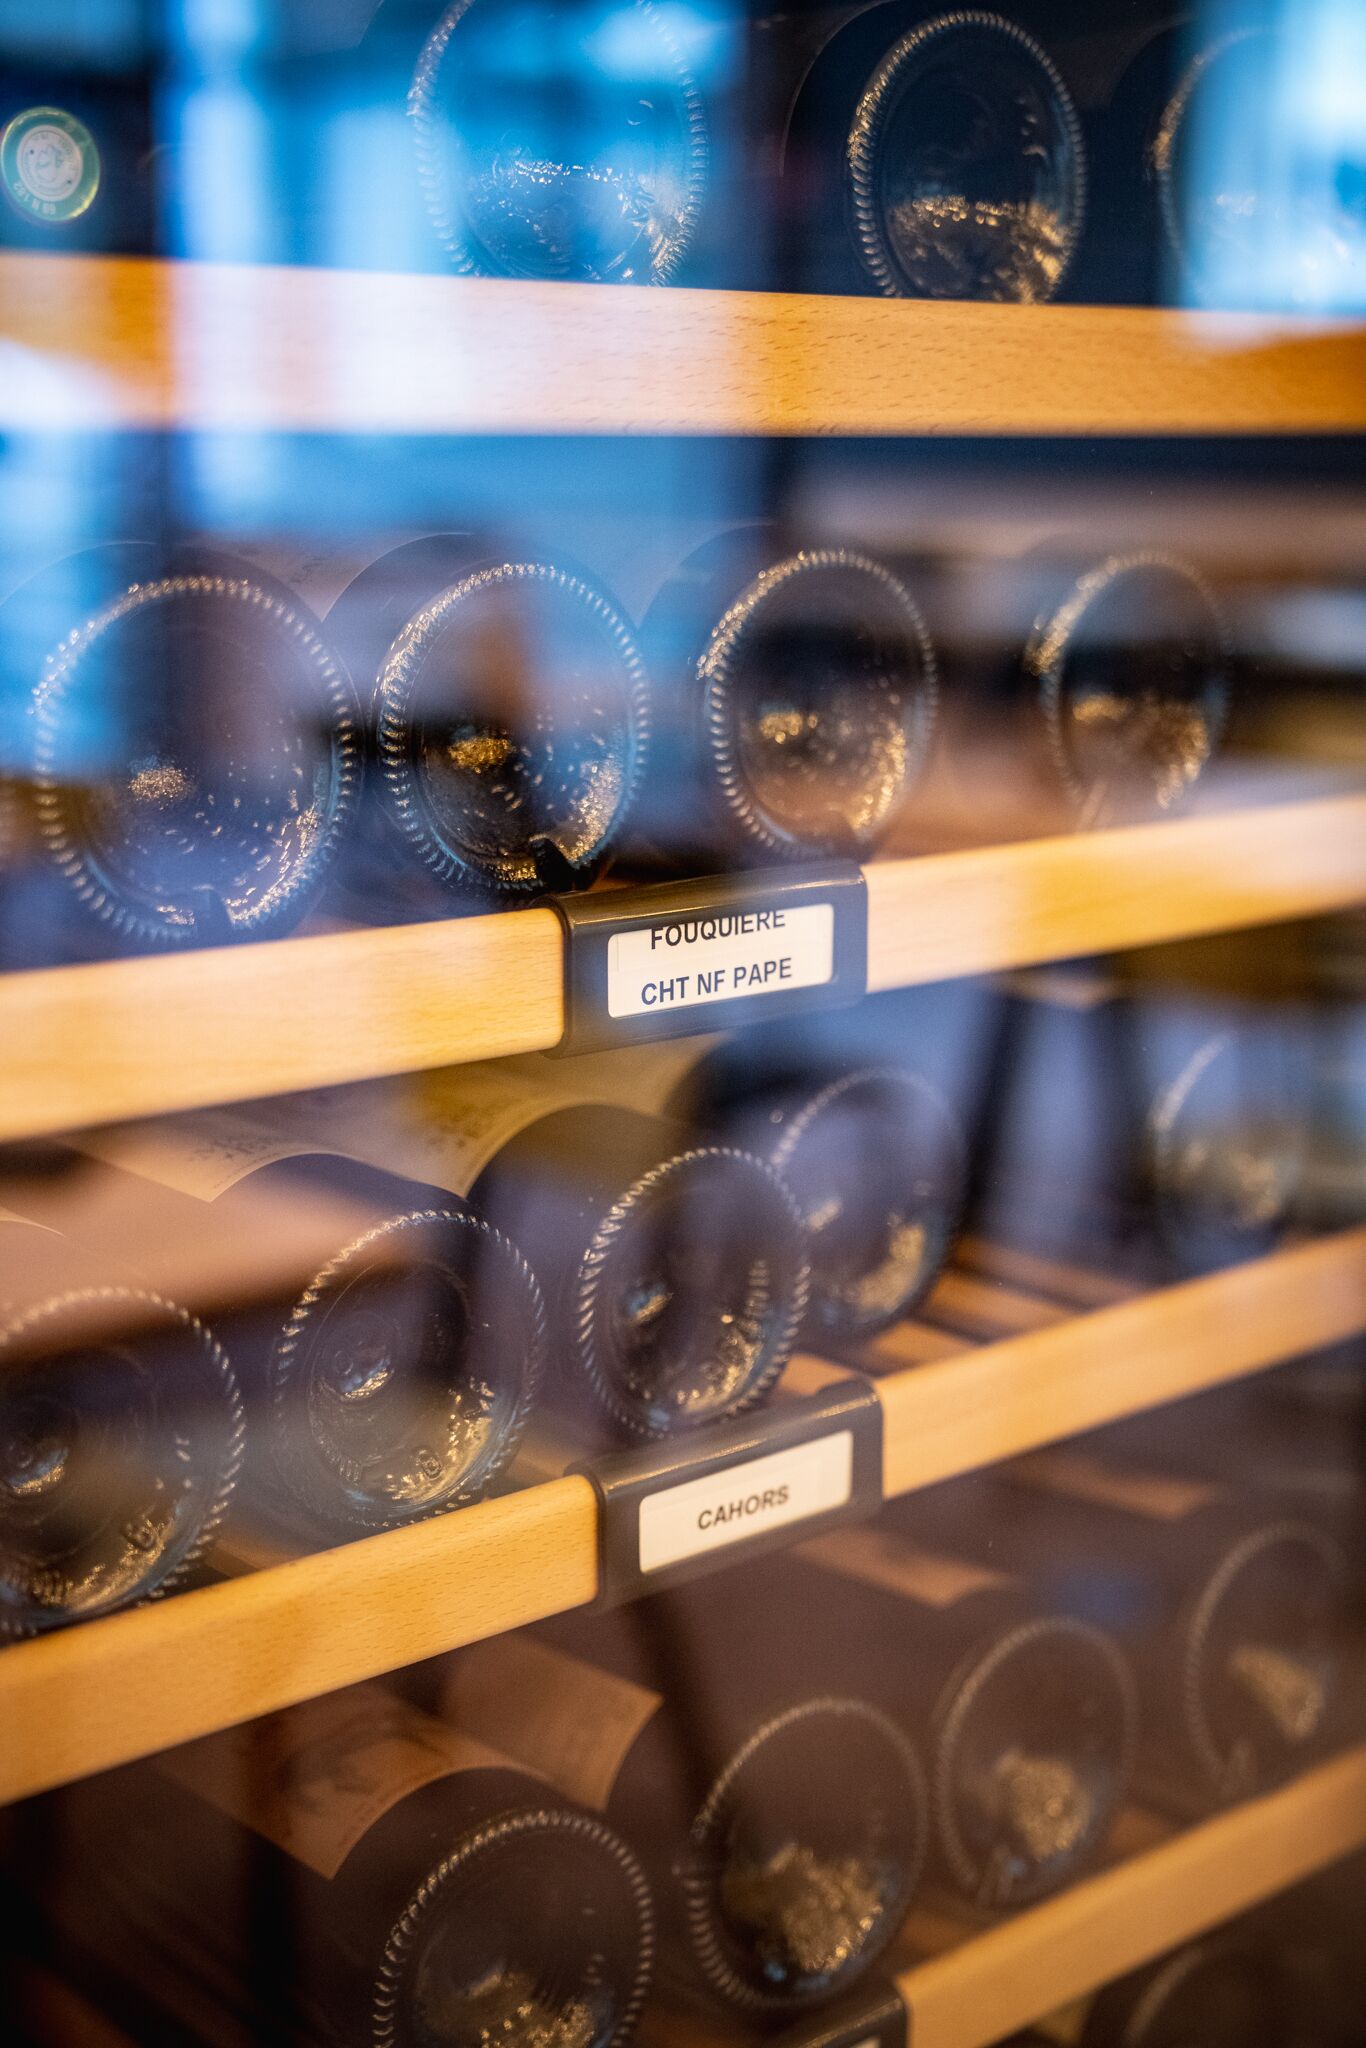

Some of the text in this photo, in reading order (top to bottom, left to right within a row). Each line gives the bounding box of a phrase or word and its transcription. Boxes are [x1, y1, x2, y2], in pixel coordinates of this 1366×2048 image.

[651, 911, 785, 949] FOUQUIERE
[641, 957, 792, 1006] CHT NF PAPE
[697, 1485, 789, 1530] CAHORS
